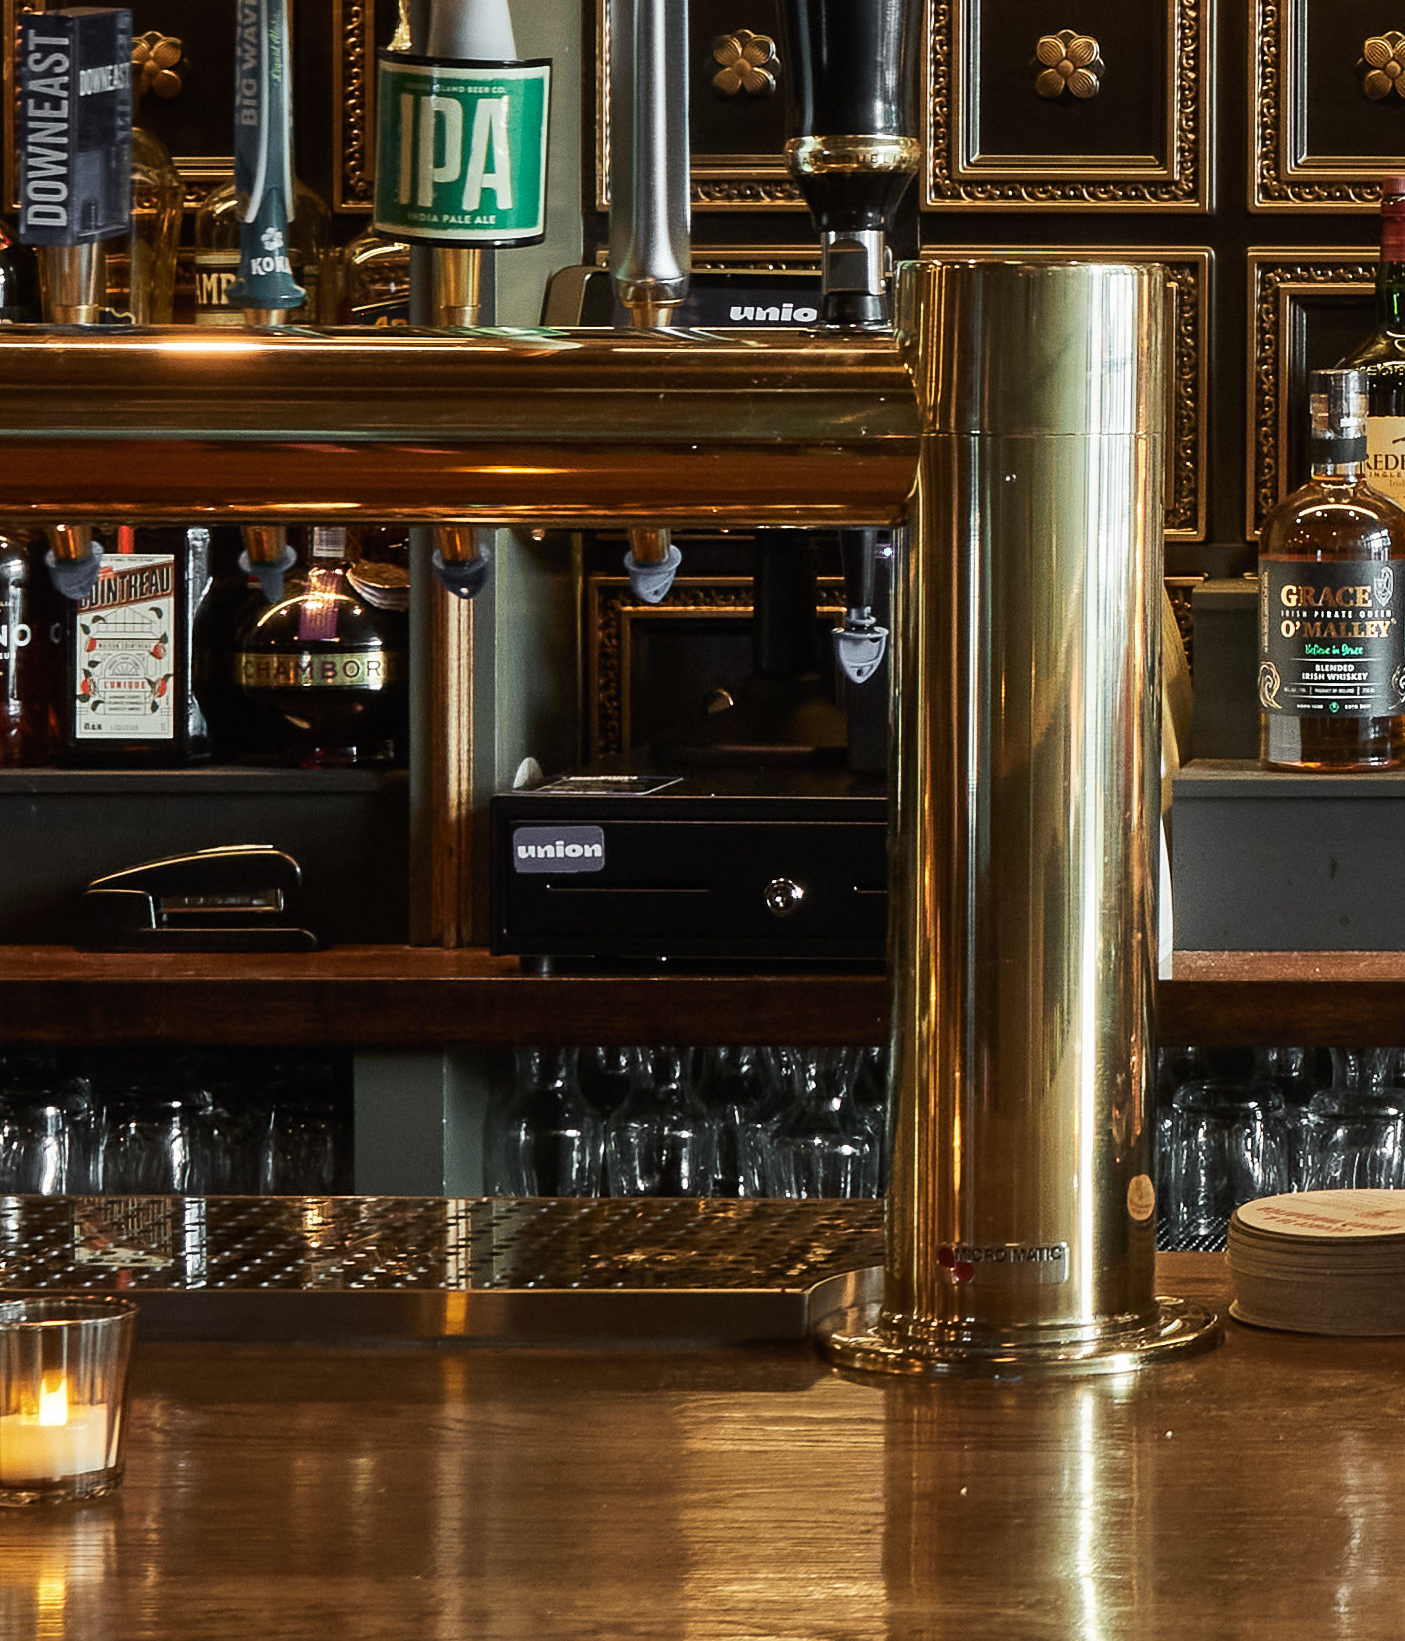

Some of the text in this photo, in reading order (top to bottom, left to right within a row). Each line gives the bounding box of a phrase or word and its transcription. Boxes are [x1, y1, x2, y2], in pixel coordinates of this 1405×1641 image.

[27, 29, 70, 228] DOWNEAST
[399, 93, 513, 211] IPA
[407, 213, 497, 224] INDIA PALE ALE
[729, 302, 818, 323] unio
[1280, 584, 1372, 607] GRACE
[1314, 610, 1352, 618] PIRATE
[1281, 619, 1391, 638] O'MALLEY
[242, 659, 383, 681] CHAMBOR
[1327, 673, 1368, 681] WHISKEY
[103, 680, 148, 689] L'UNIQUE
[517, 841, 602, 859] union
